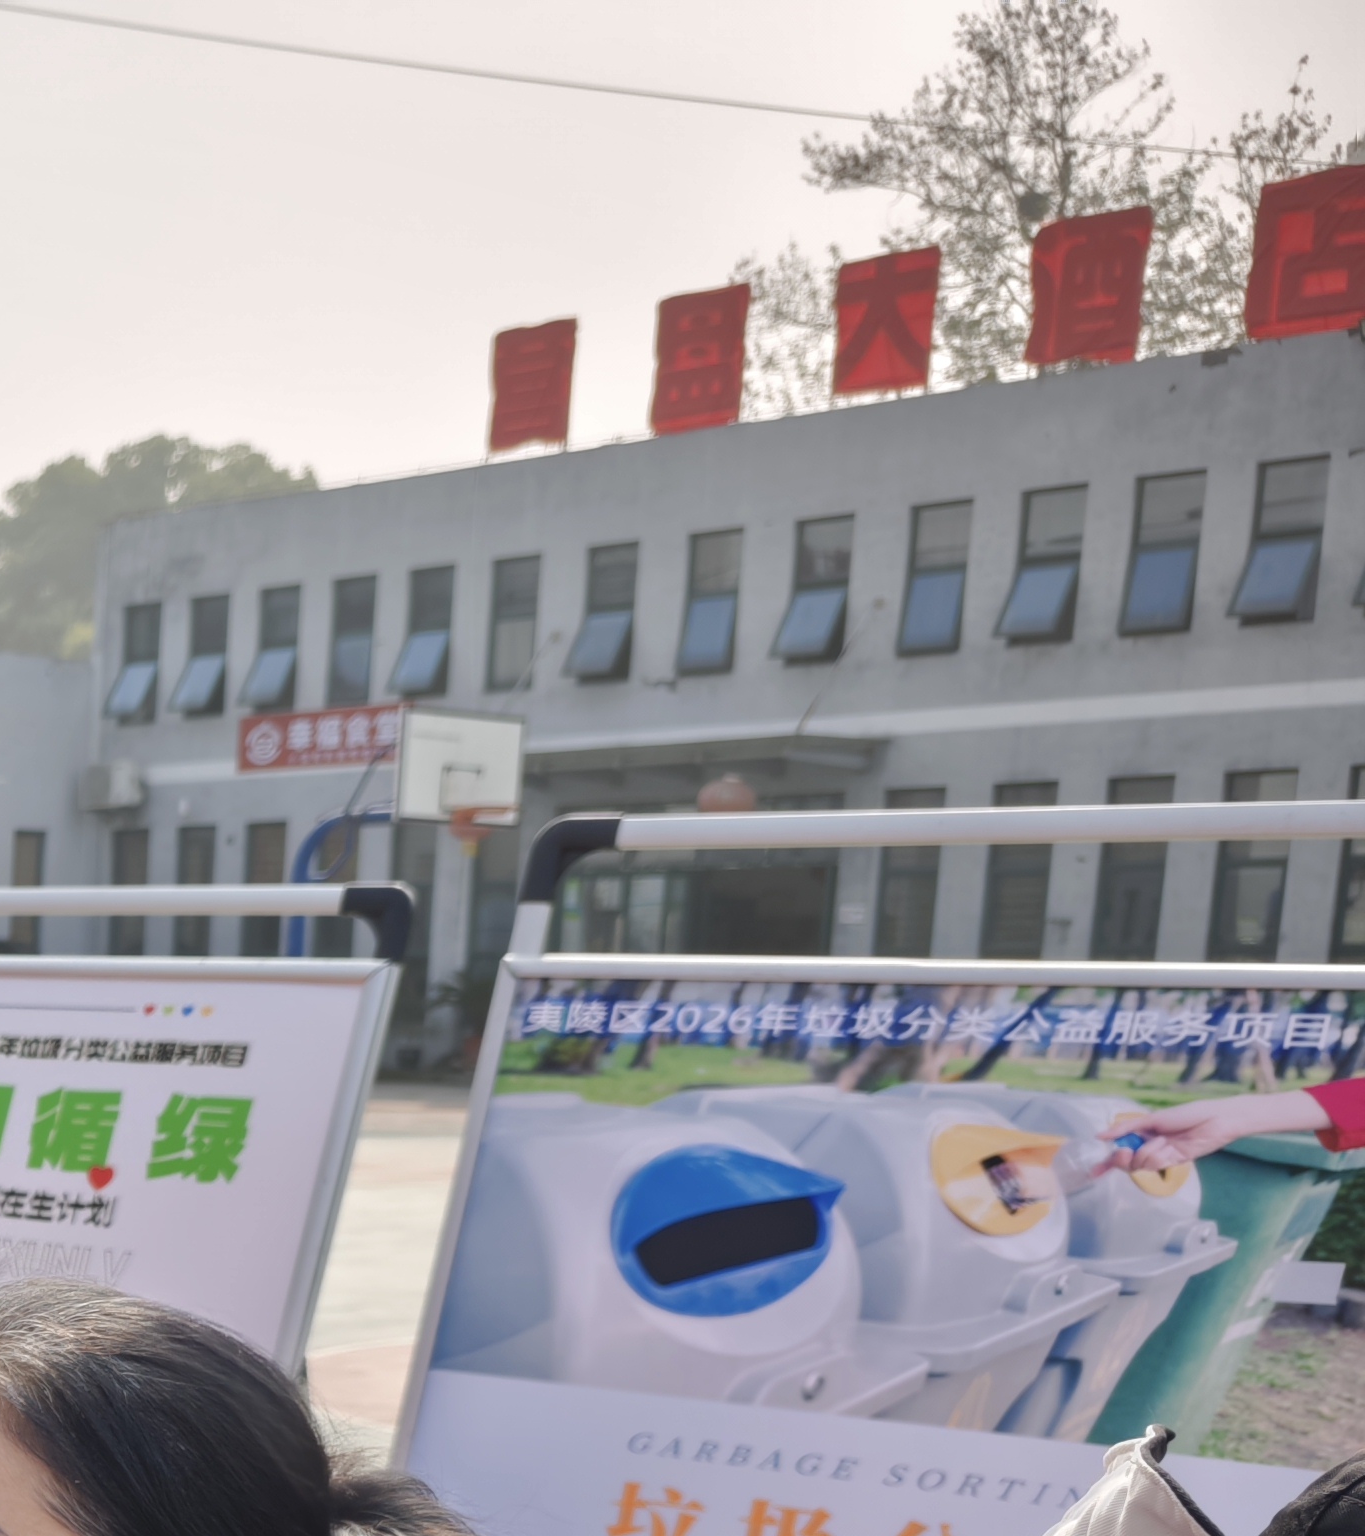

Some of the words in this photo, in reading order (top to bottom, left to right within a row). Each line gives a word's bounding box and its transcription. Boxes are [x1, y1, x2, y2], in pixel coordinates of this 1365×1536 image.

[522, 1000, 1335, 1050] 夷陵区2026年垃圾分类公益服务项目
[626, 1431, 860, 1482] GARBAGE
